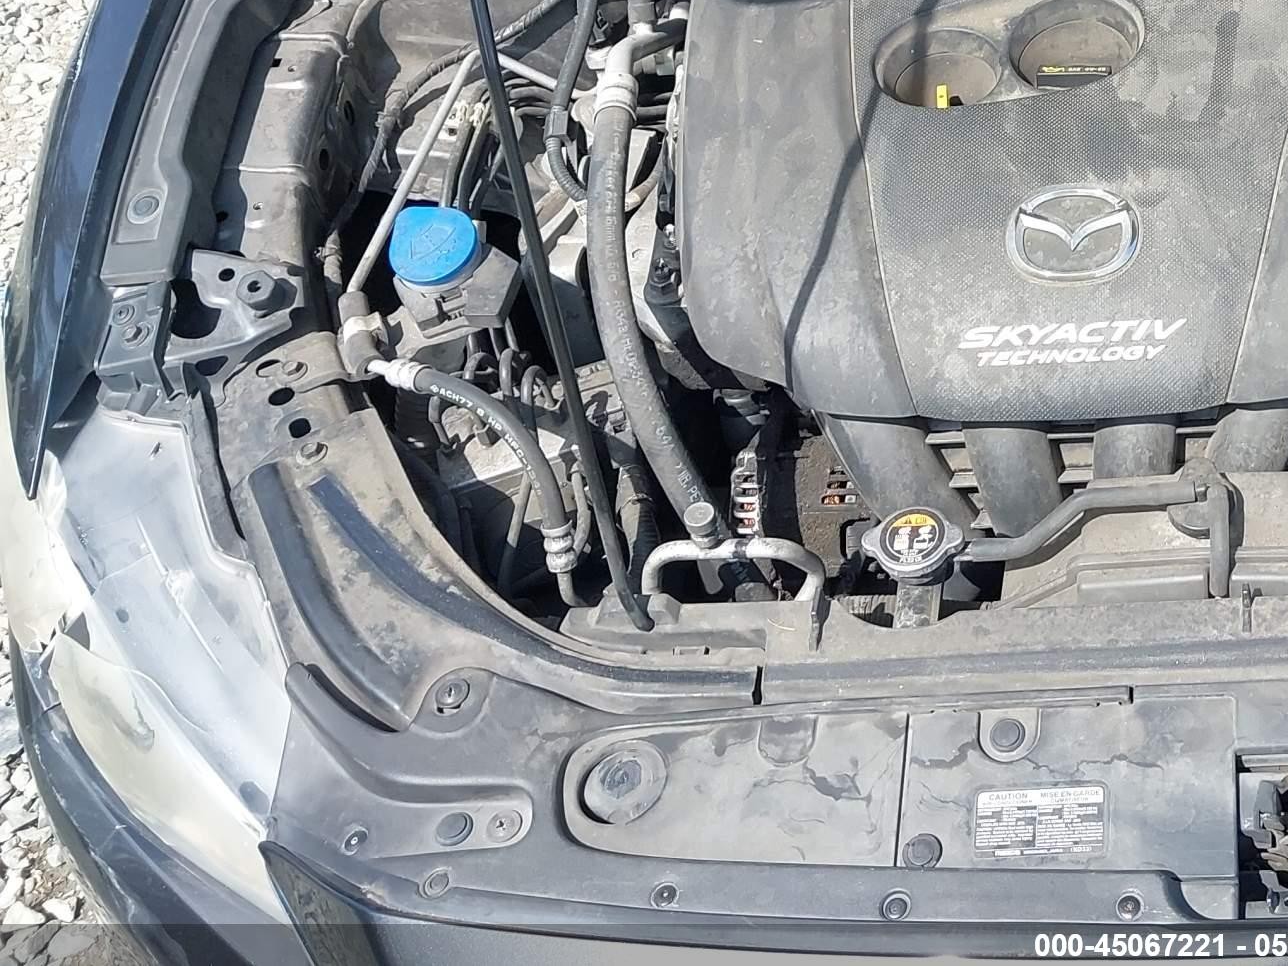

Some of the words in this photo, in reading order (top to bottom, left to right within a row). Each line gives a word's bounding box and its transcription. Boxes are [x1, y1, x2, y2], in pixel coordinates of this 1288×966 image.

[957, 318, 1188, 349] SKYACTIV
[976, 344, 1168, 367] TECHNOLOGY
[989, 792, 1028, 801] CAUTION
